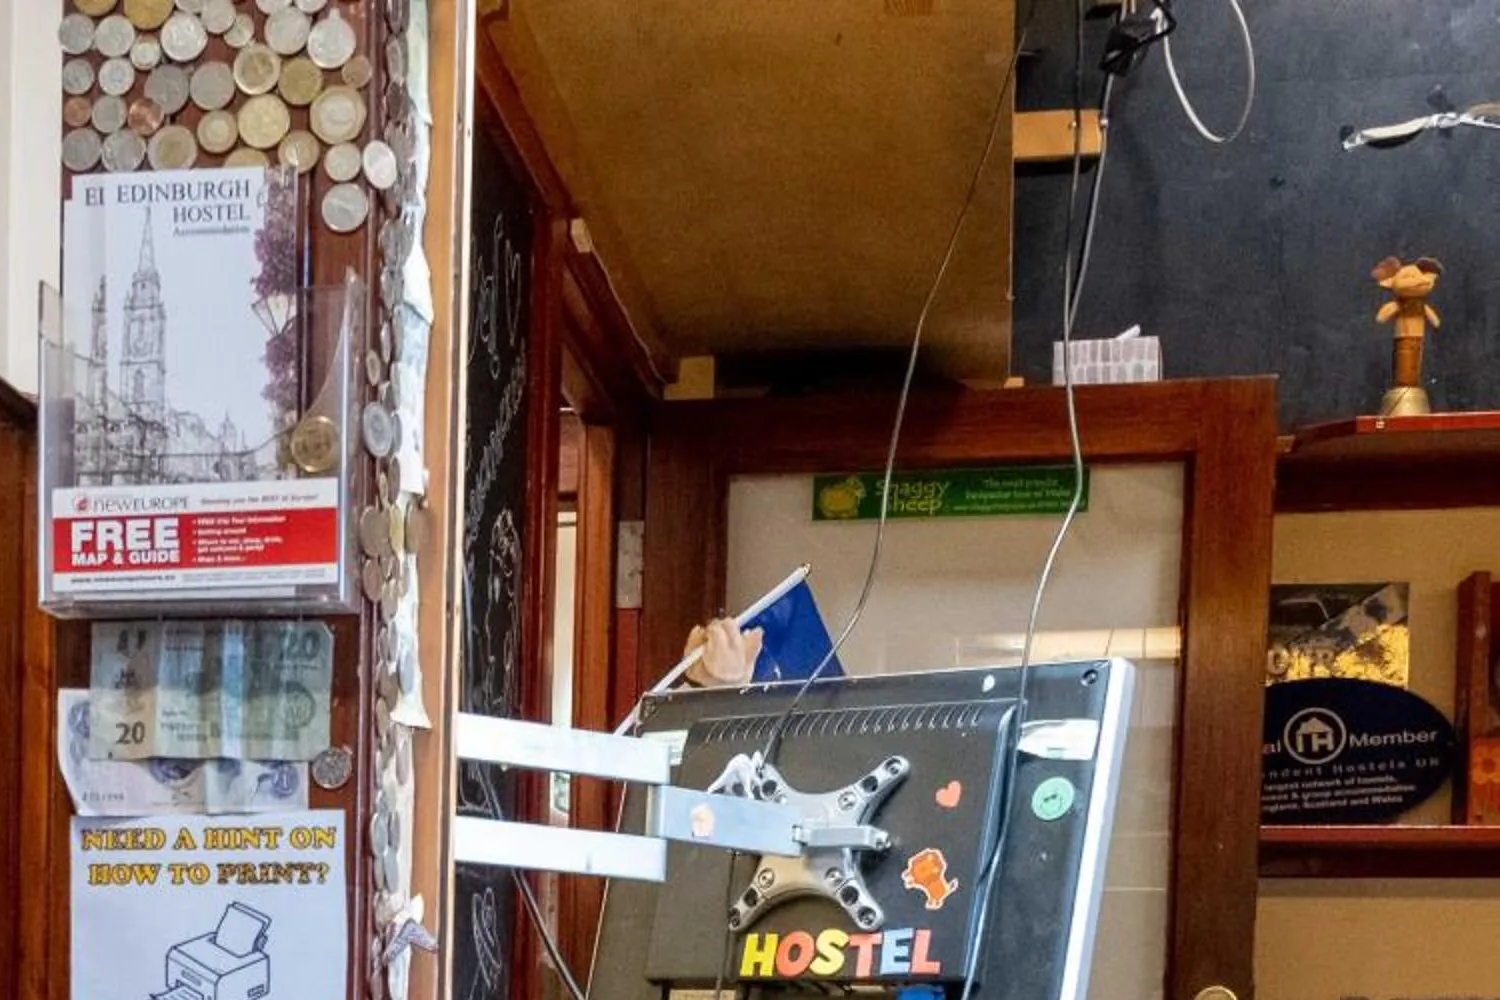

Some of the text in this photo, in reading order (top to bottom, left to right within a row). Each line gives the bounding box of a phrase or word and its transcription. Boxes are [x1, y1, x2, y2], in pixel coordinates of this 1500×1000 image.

[117, 179, 250, 203] EDINBURGH
[173, 204, 250, 224] HOSTEL
[71, 517, 179, 553] FREE
[72, 551, 108, 567] MAP
[112, 550, 124, 565] &
[129, 549, 179, 565] GUIDE
[115, 721, 146, 744] 20
[1350, 730, 1439, 748] Member
[80, 826, 337, 851] NEED A HINT ON
[88, 862, 331, 886] HOW TO PRINT?
[739, 926, 942, 979] HOSTEL
